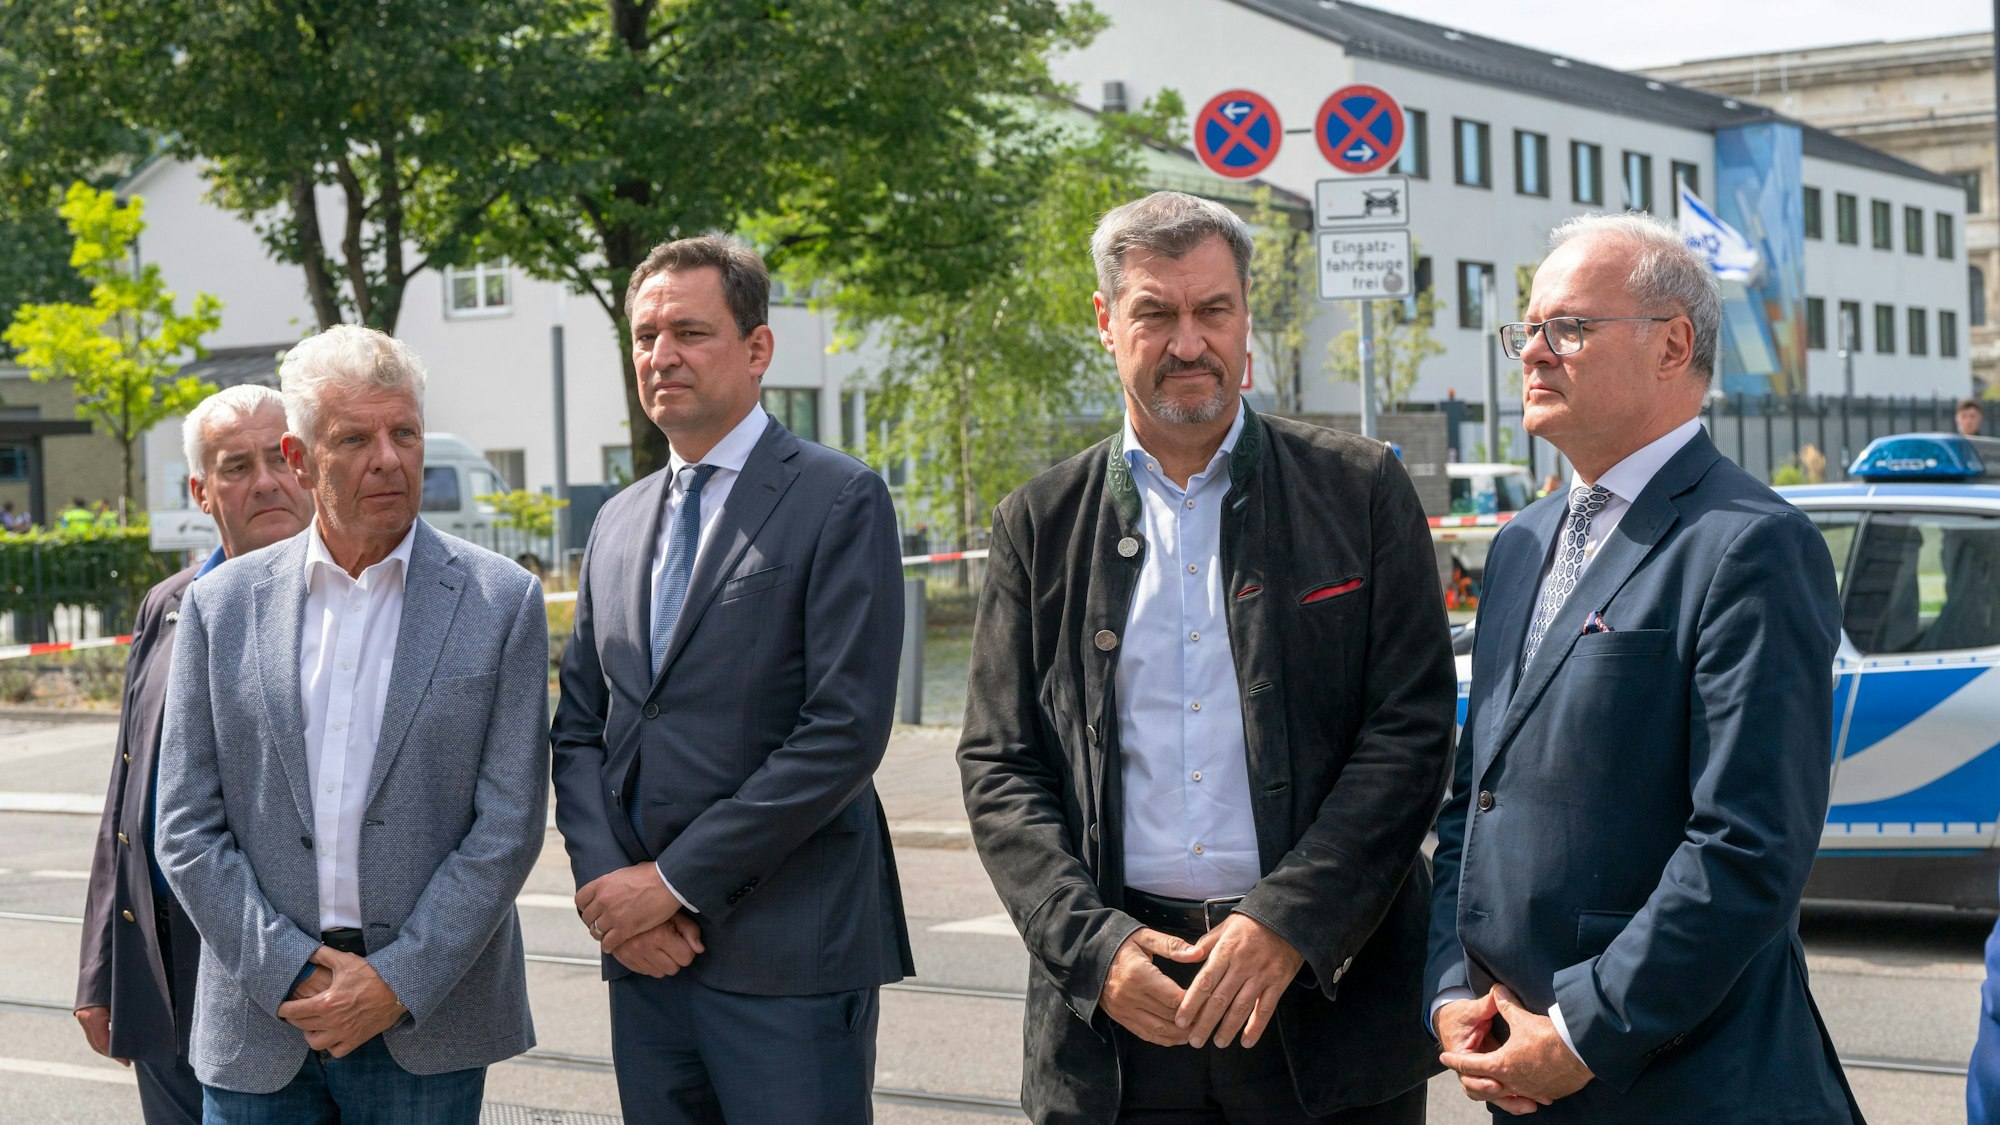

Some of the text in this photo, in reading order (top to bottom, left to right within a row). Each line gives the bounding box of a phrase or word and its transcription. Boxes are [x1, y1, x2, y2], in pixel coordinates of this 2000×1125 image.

[1332, 240, 1396, 255] Einsatz-
[1327, 259, 1403, 275] fahrzeuge
[1352, 276, 1379, 289] frei
